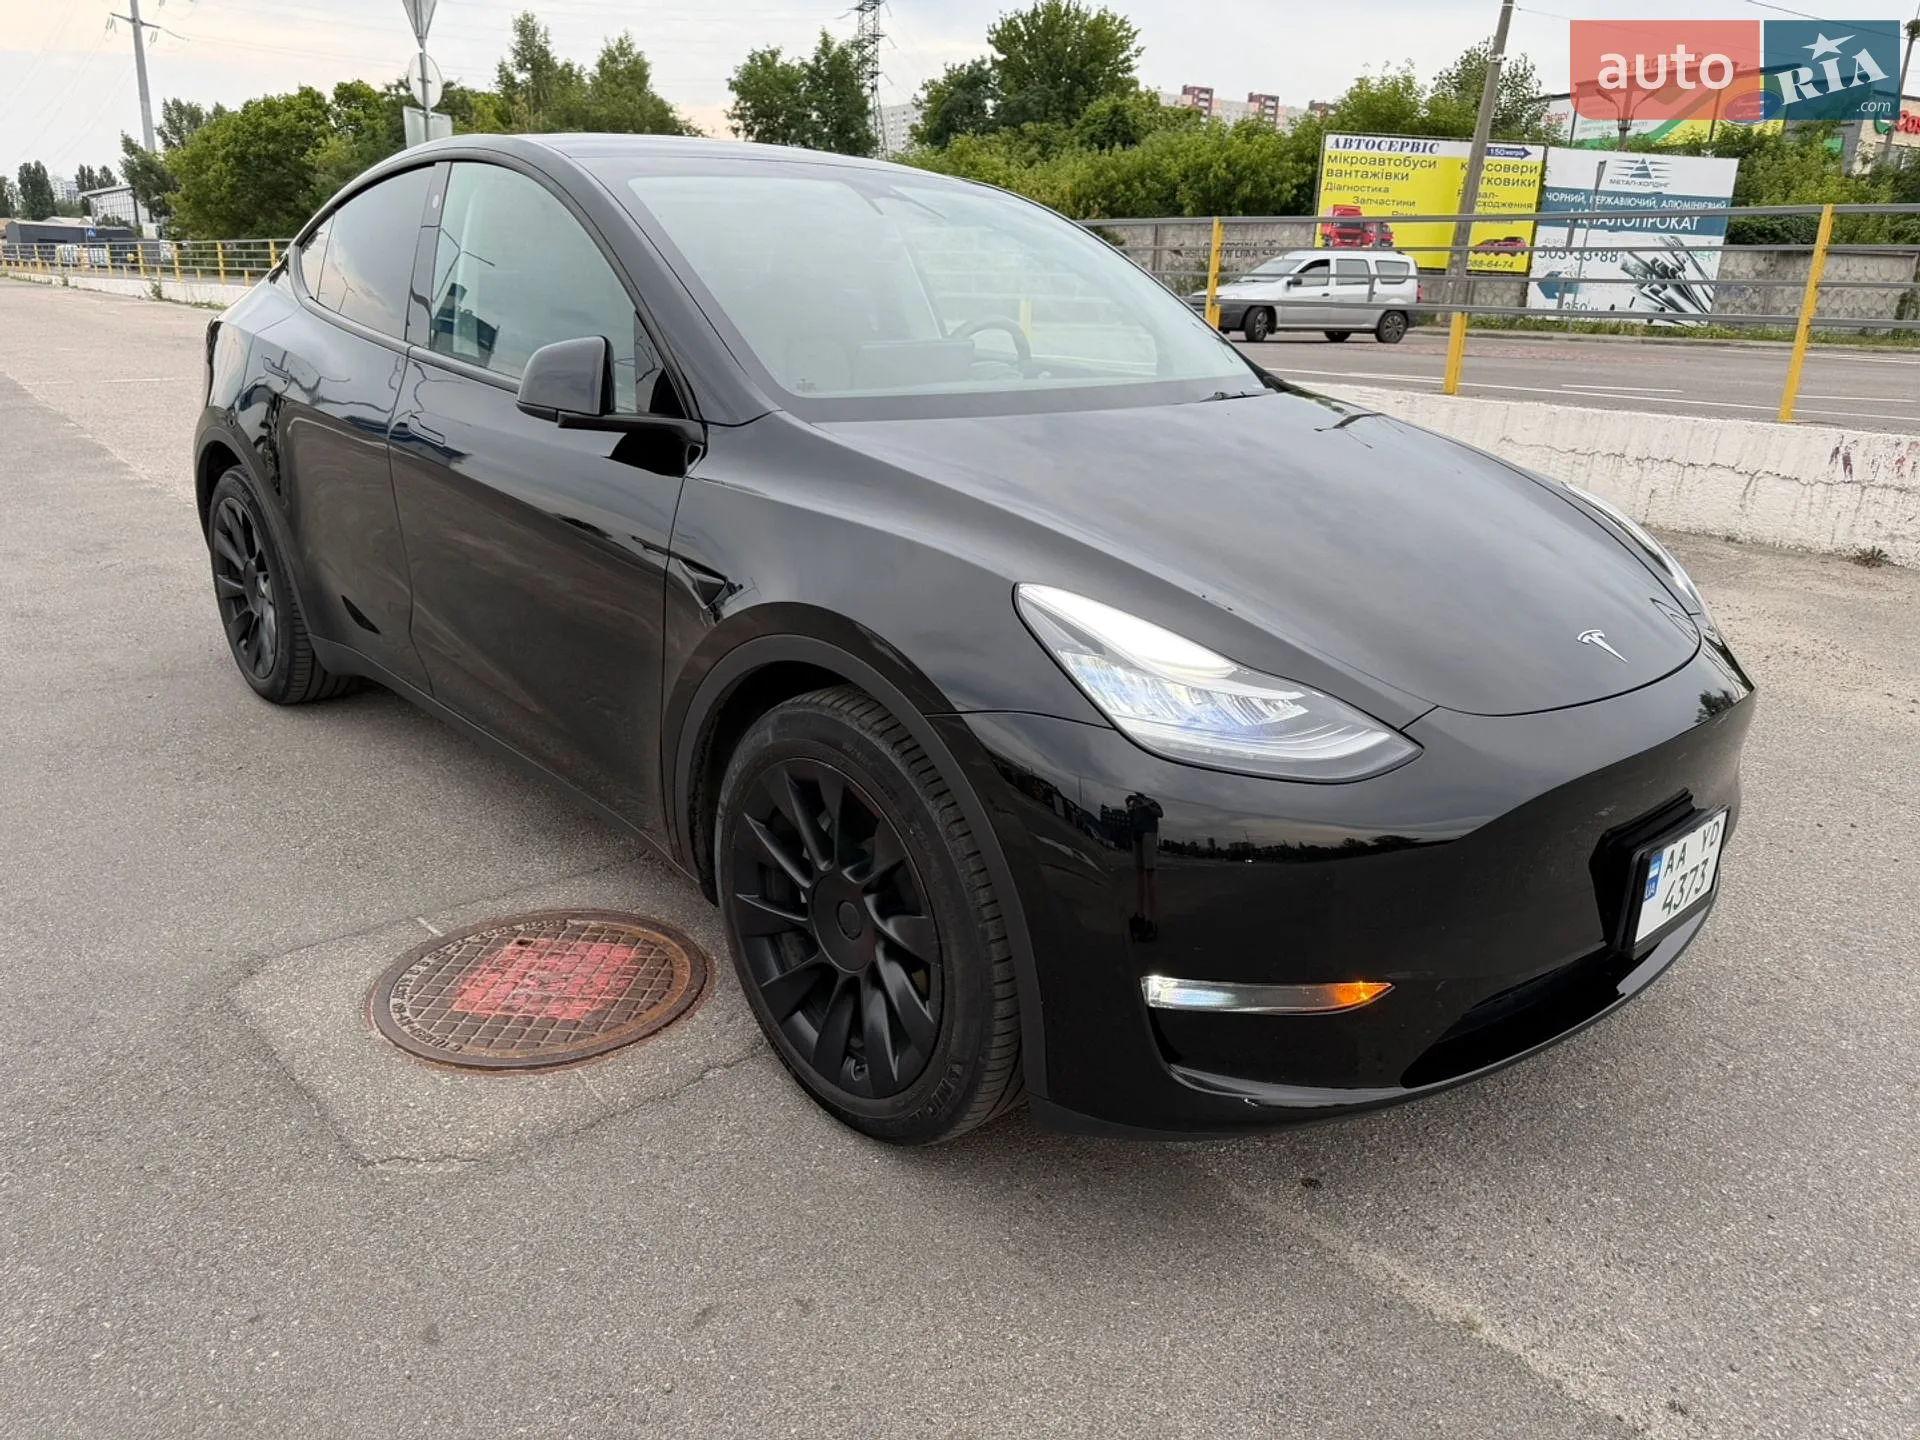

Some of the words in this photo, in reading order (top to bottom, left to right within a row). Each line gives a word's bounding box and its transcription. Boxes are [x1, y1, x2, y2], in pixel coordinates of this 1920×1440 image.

[1331, 137, 1439, 154] АВТОСЕРВІС
[1327, 153, 1437, 170] мікроавтобуси
[1326, 168, 1409, 180] вантажівки
[1325, 182, 1389, 193] Діагностика
[1352, 196, 1416, 207] Запчастини
[1546, 191, 1586, 204] ЧОРНИЙ,
[1664, 842, 1687, 878] AA
[1661, 857, 1709, 915] 4373
